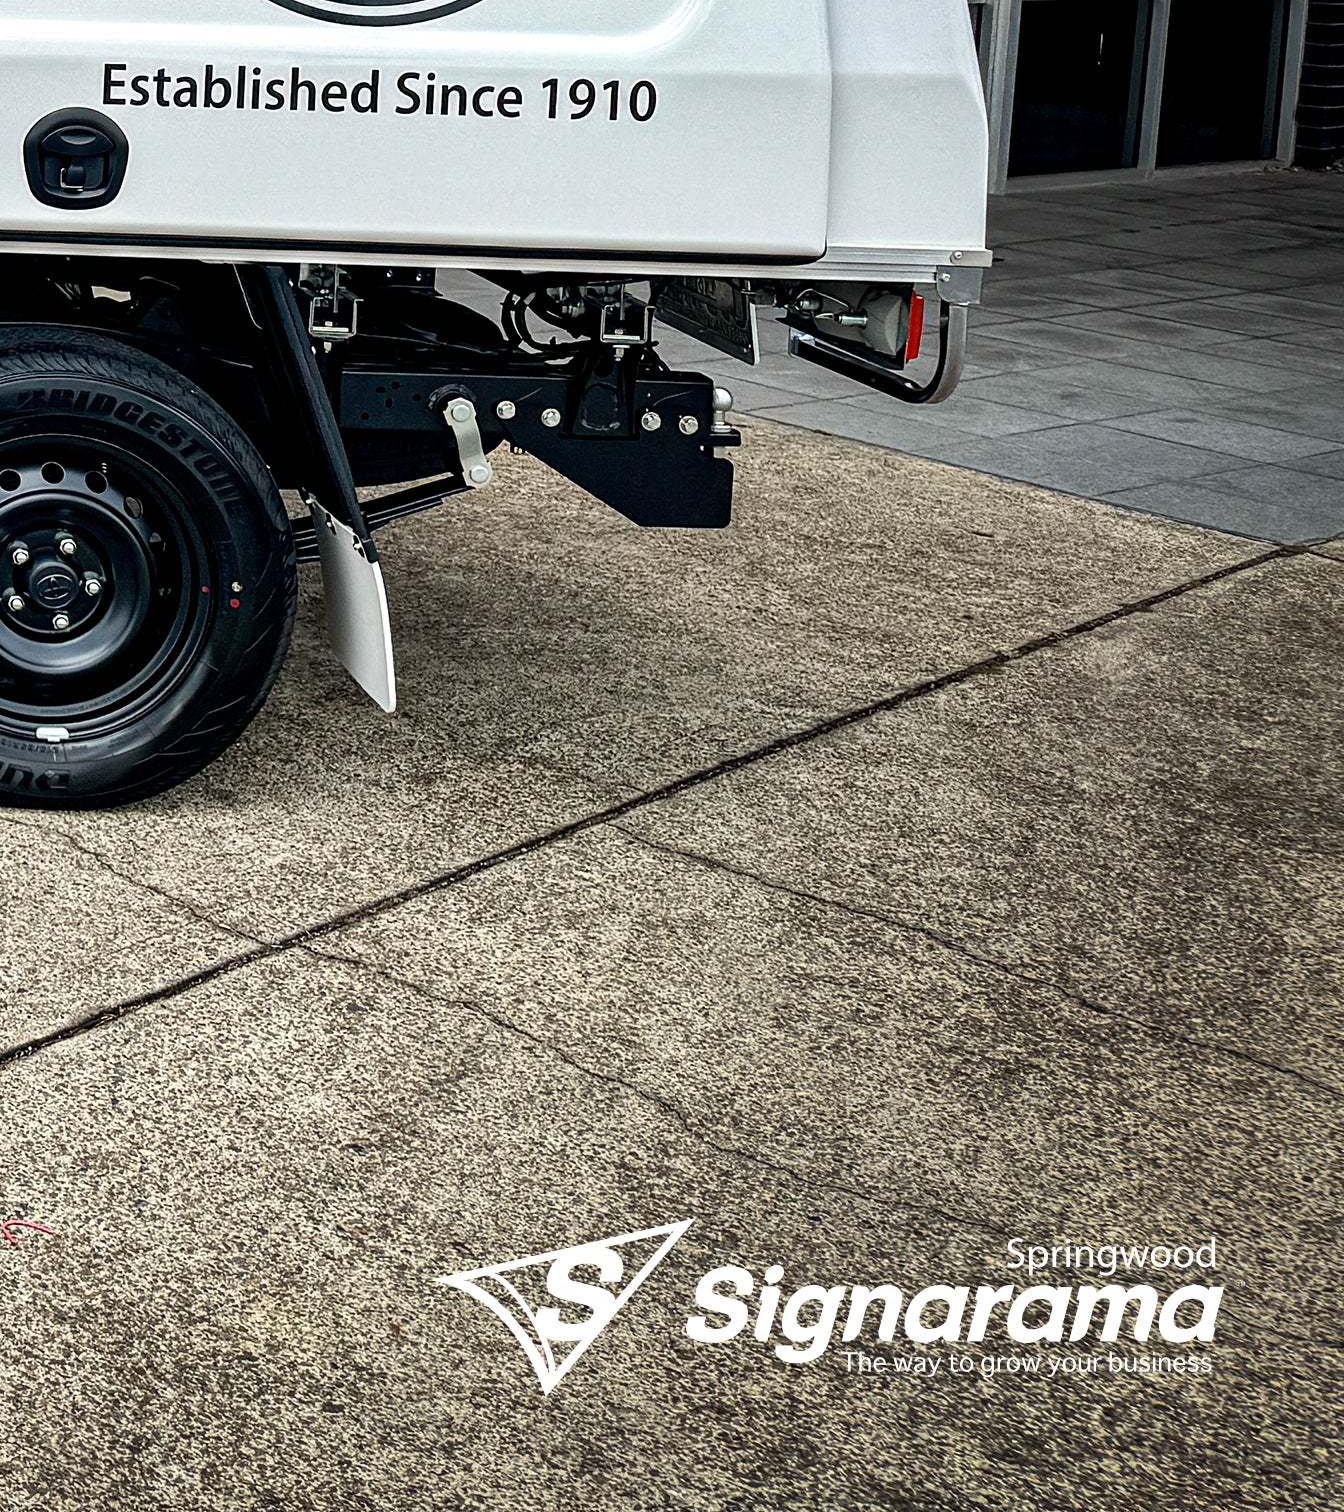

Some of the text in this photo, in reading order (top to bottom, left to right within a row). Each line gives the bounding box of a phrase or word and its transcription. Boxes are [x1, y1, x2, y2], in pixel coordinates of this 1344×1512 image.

[102, 63, 657, 122] Established Since 1910
